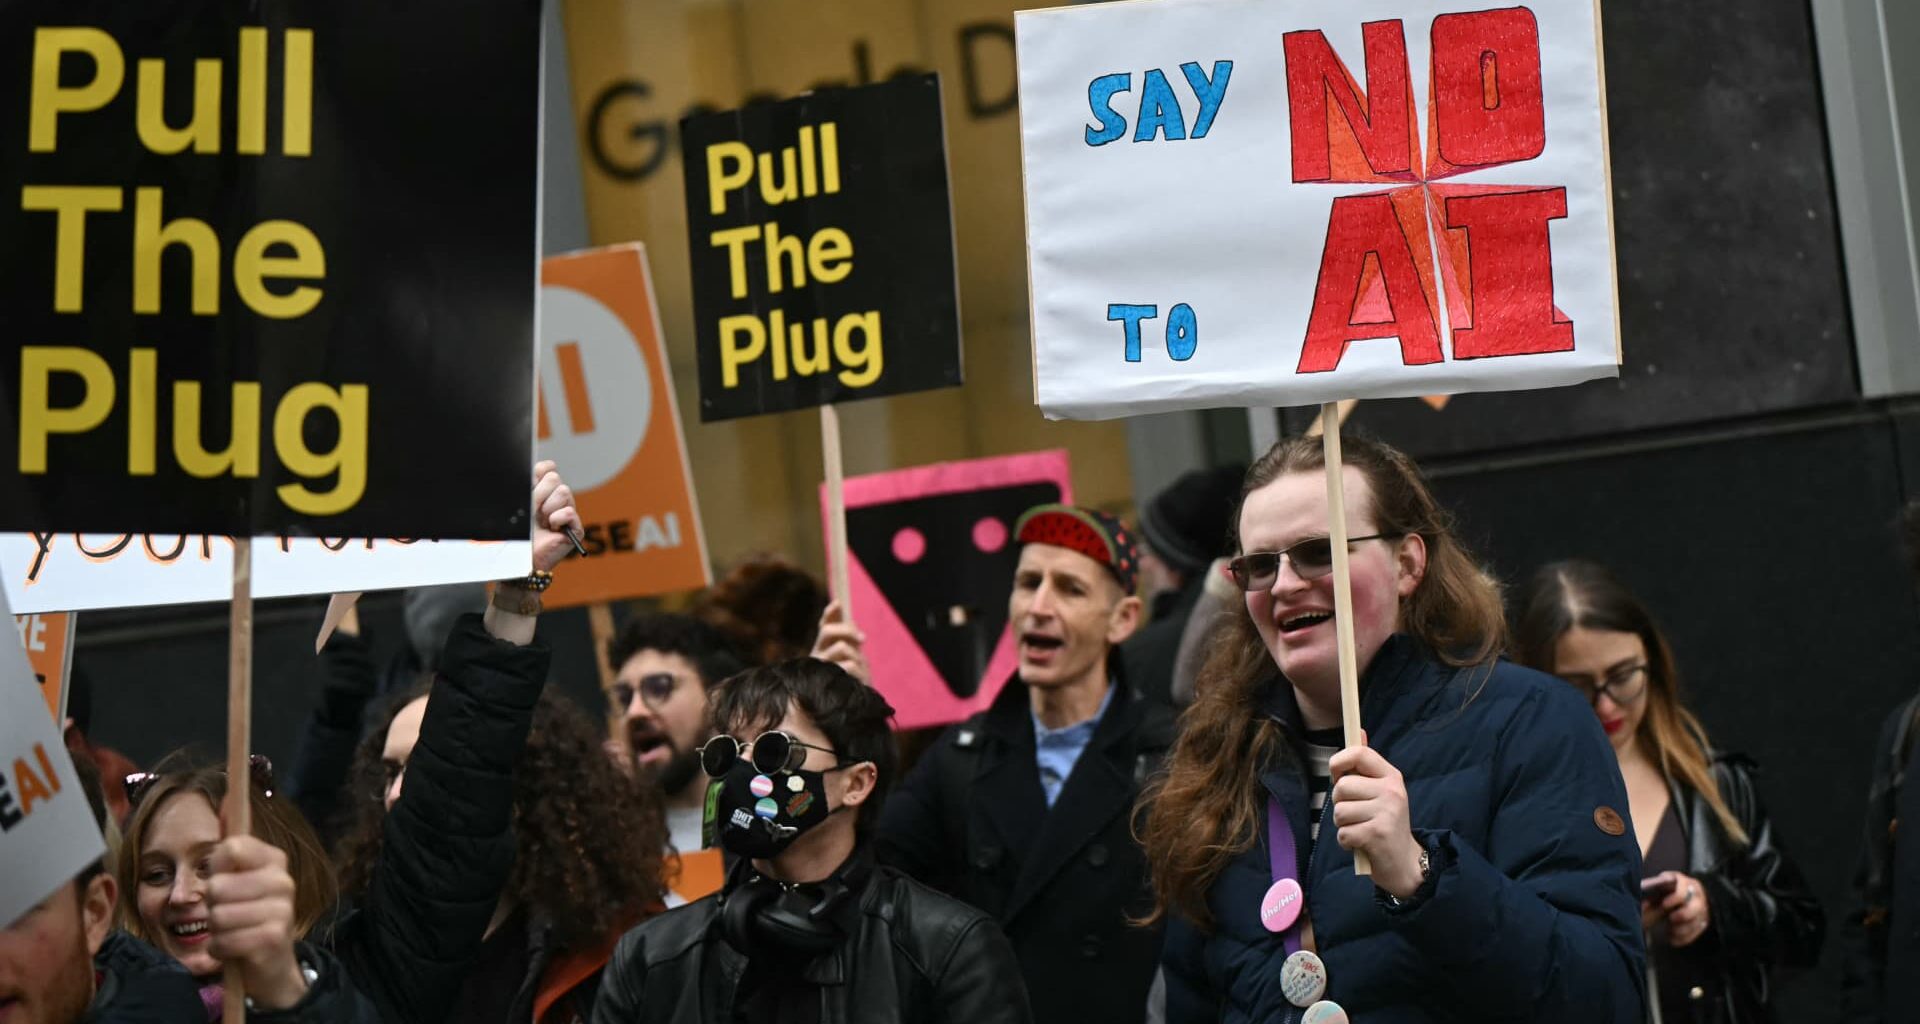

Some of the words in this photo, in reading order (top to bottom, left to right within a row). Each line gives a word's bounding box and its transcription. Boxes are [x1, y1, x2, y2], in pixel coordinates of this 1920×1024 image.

[29, 26, 313, 157] Pull
[1085, 60, 1233, 146] SAY
[1283, 5, 1545, 184] NO
[706, 122, 840, 215] Pull
[21, 185, 327, 319] The
[710, 222, 854, 300] The
[1107, 302, 1198, 363] TO
[1296, 186, 1576, 374] AI
[719, 309, 884, 389] Plug
[19, 346, 369, 516] Plug
[567, 512, 682, 558] SEAI
